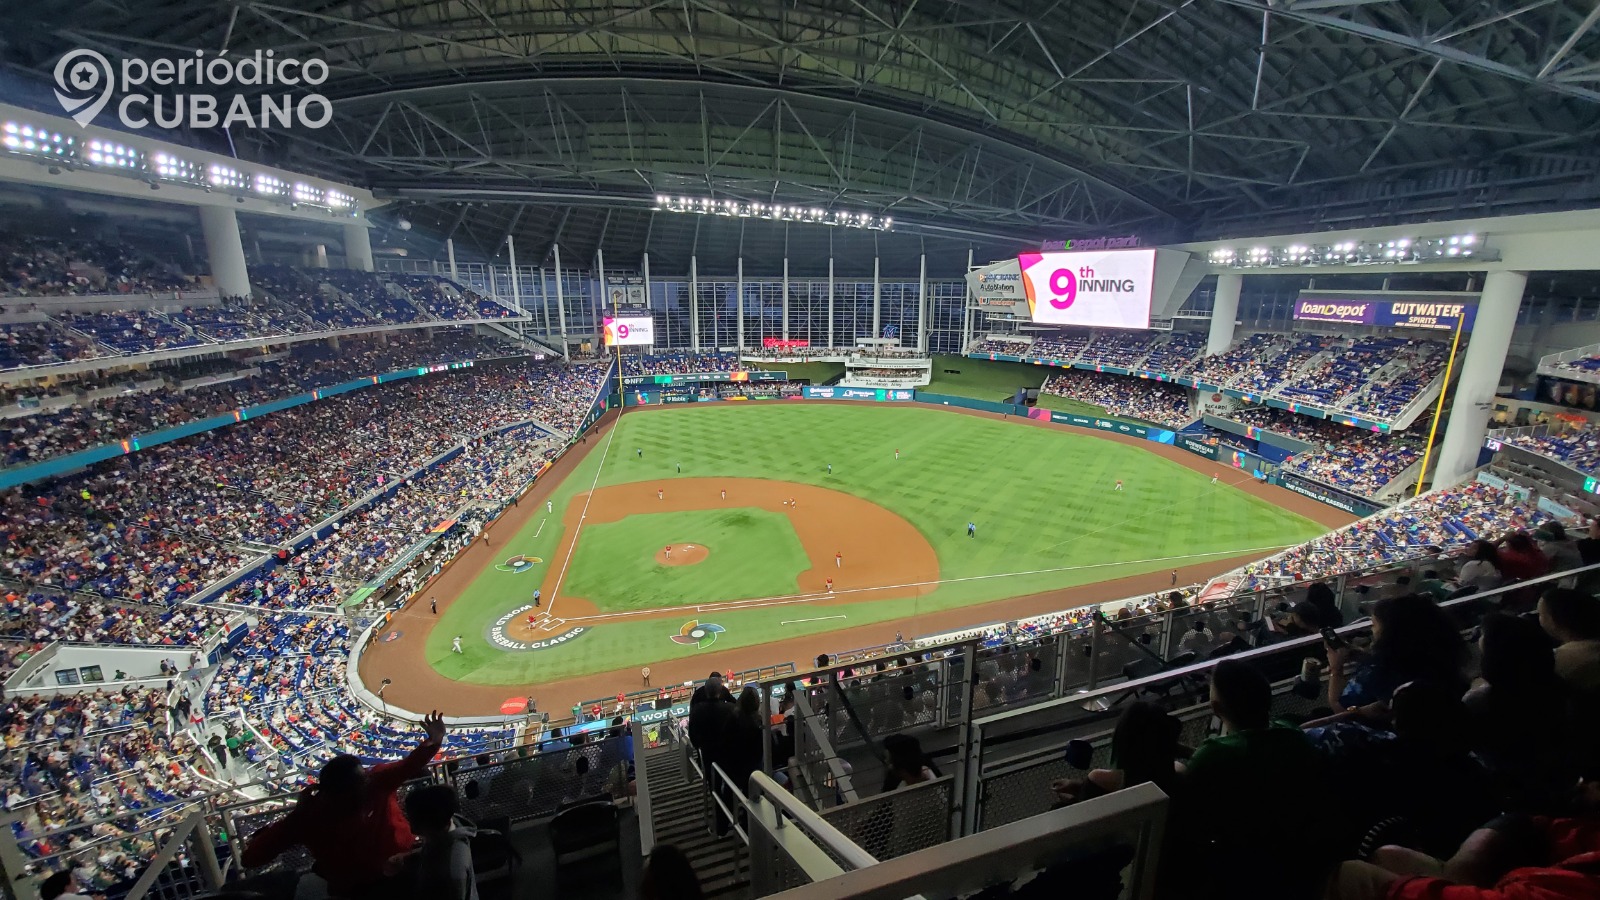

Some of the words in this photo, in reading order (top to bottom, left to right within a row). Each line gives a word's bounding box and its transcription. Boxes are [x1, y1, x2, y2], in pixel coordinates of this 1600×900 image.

[1079, 279, 1134, 292] INNING
[1300, 302, 1367, 318] loanDepot
[1391, 303, 1461, 317] CUTWATER
[1408, 316, 1437, 324] SPIRITS
[1295, 487, 1318, 499] FESTIVAL
[1325, 497, 1354, 512] BASEBALL
[496, 604, 533, 626] WORLD
[491, 626, 527, 649] BASEBALL
[531, 627, 584, 649] CLASSIC
